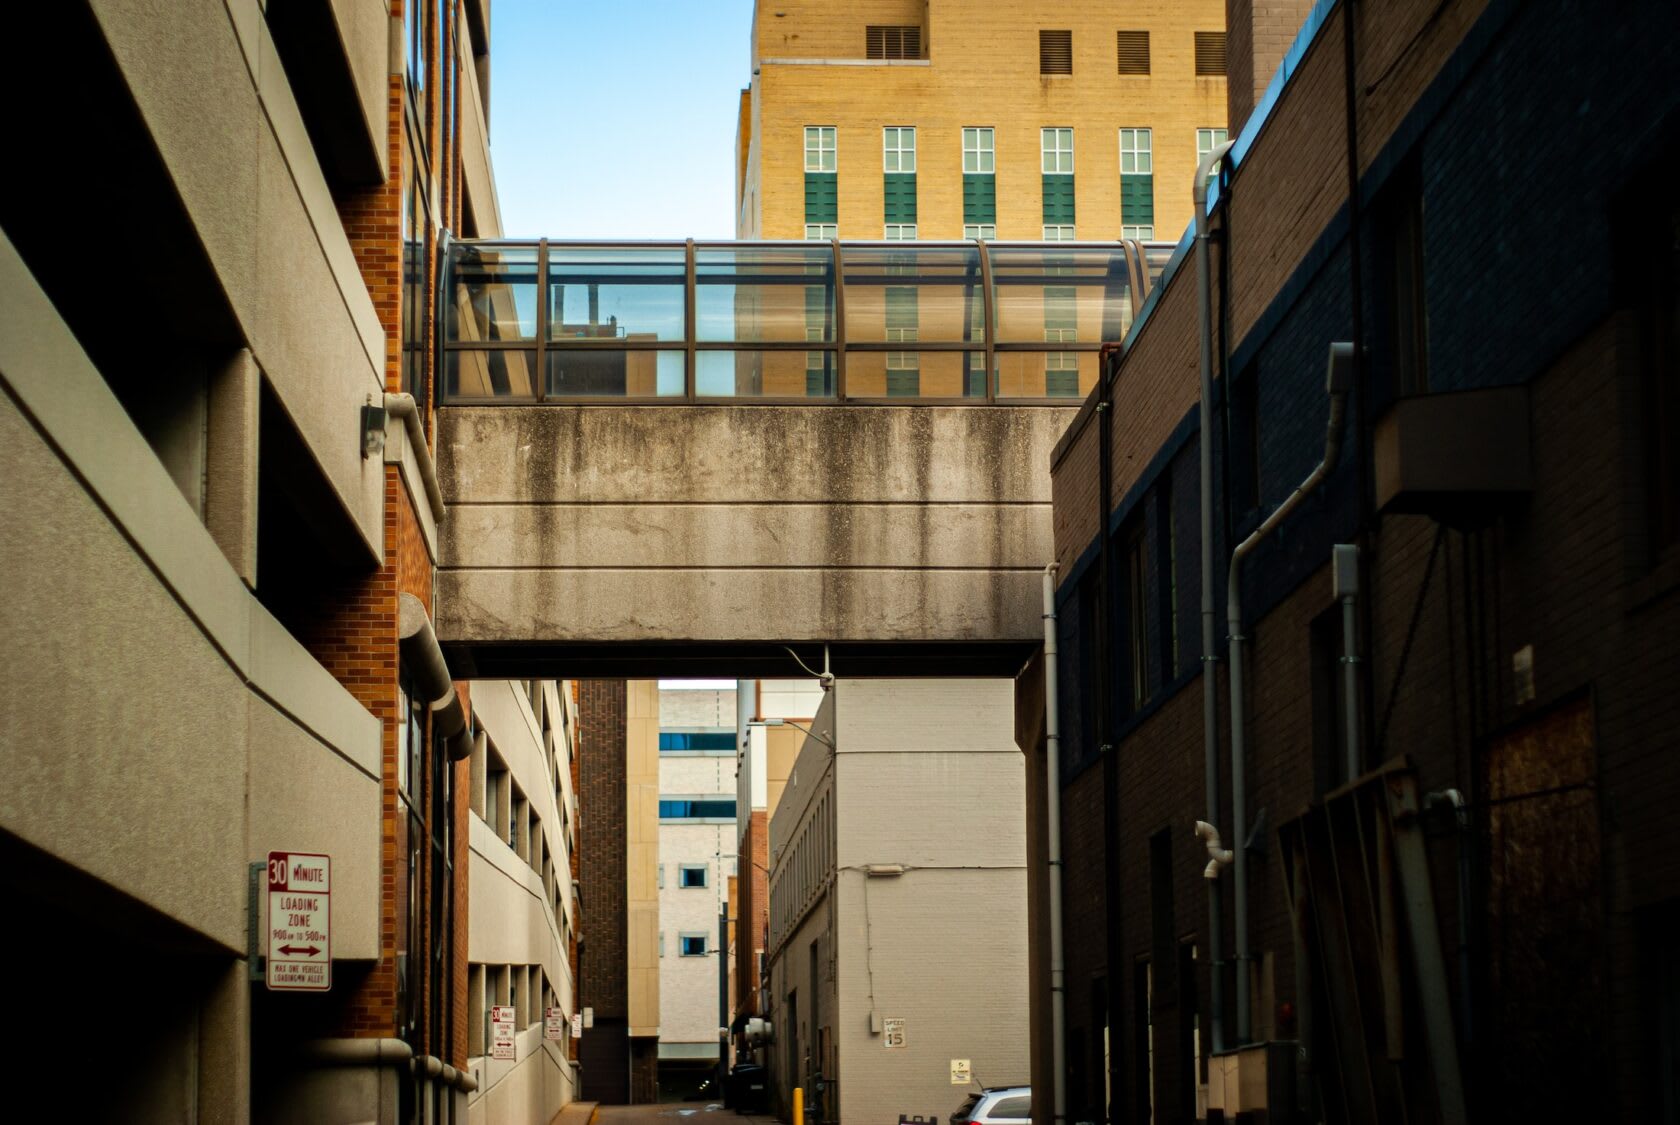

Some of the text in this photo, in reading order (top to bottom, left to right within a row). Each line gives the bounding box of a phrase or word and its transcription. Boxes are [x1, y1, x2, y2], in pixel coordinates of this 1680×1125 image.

[270, 859, 323, 884] 30 MINUTE
[280, 897, 318, 911] LOADING
[288, 913, 310, 927] ZONE
[302, 965, 323, 974] VEHICLE
[307, 974, 324, 983] ALLEY
[888, 1033, 903, 1045] 15
